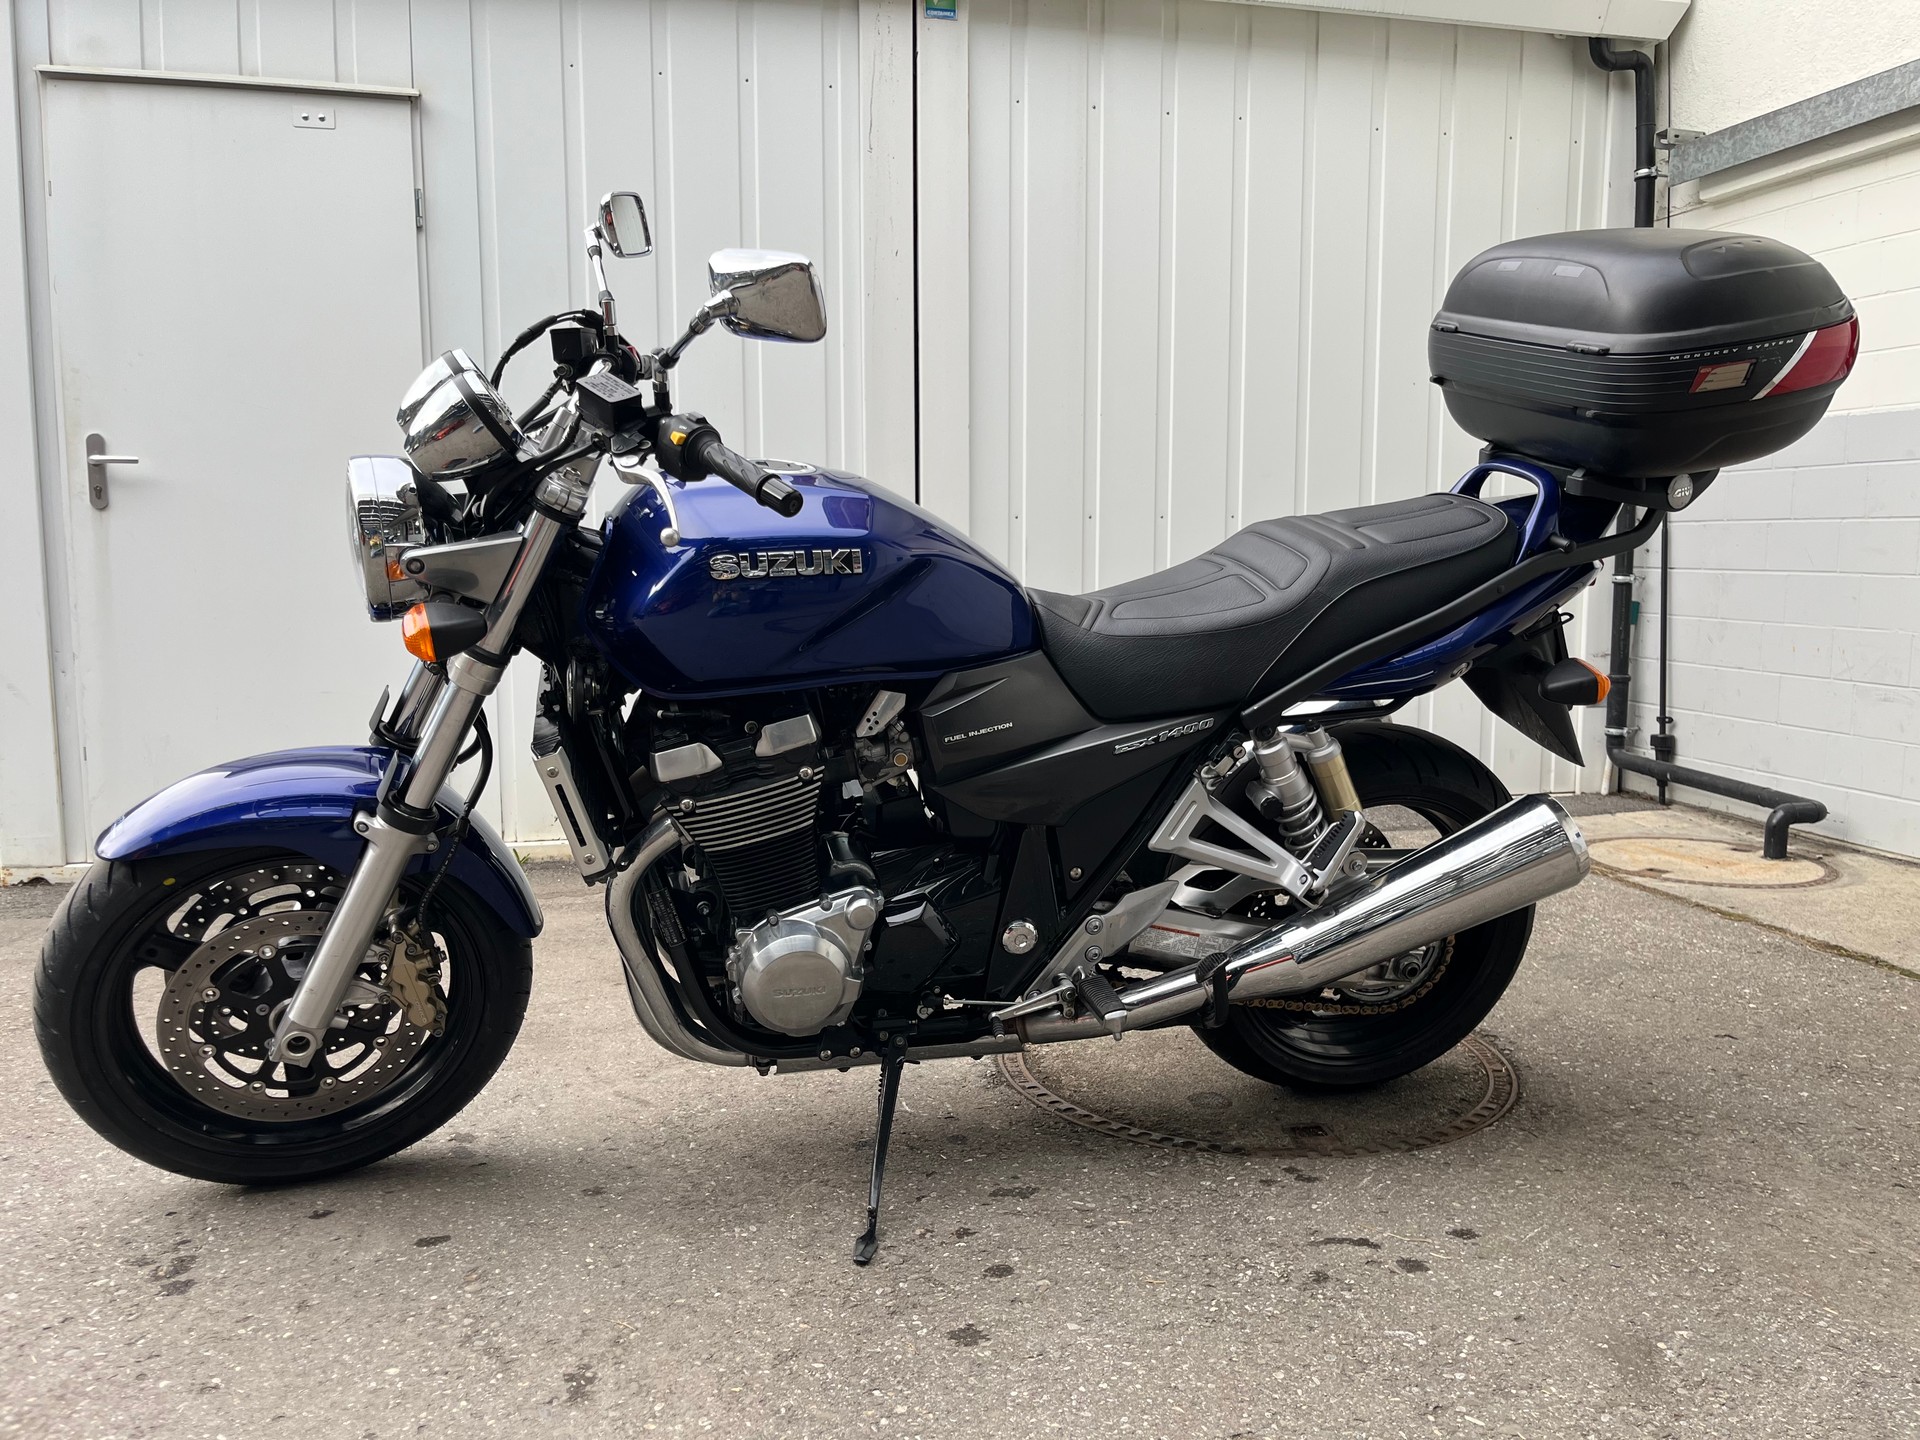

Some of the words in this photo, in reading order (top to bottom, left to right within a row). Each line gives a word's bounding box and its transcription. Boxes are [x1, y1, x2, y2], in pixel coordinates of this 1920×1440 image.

[1669, 348, 1738, 360] MONOKEY
[1747, 339, 1794, 350] SYSTEM
[709, 549, 863, 580] SUZUKI
[944, 733, 967, 743] FUEL
[968, 722, 1013, 737] INJECTION
